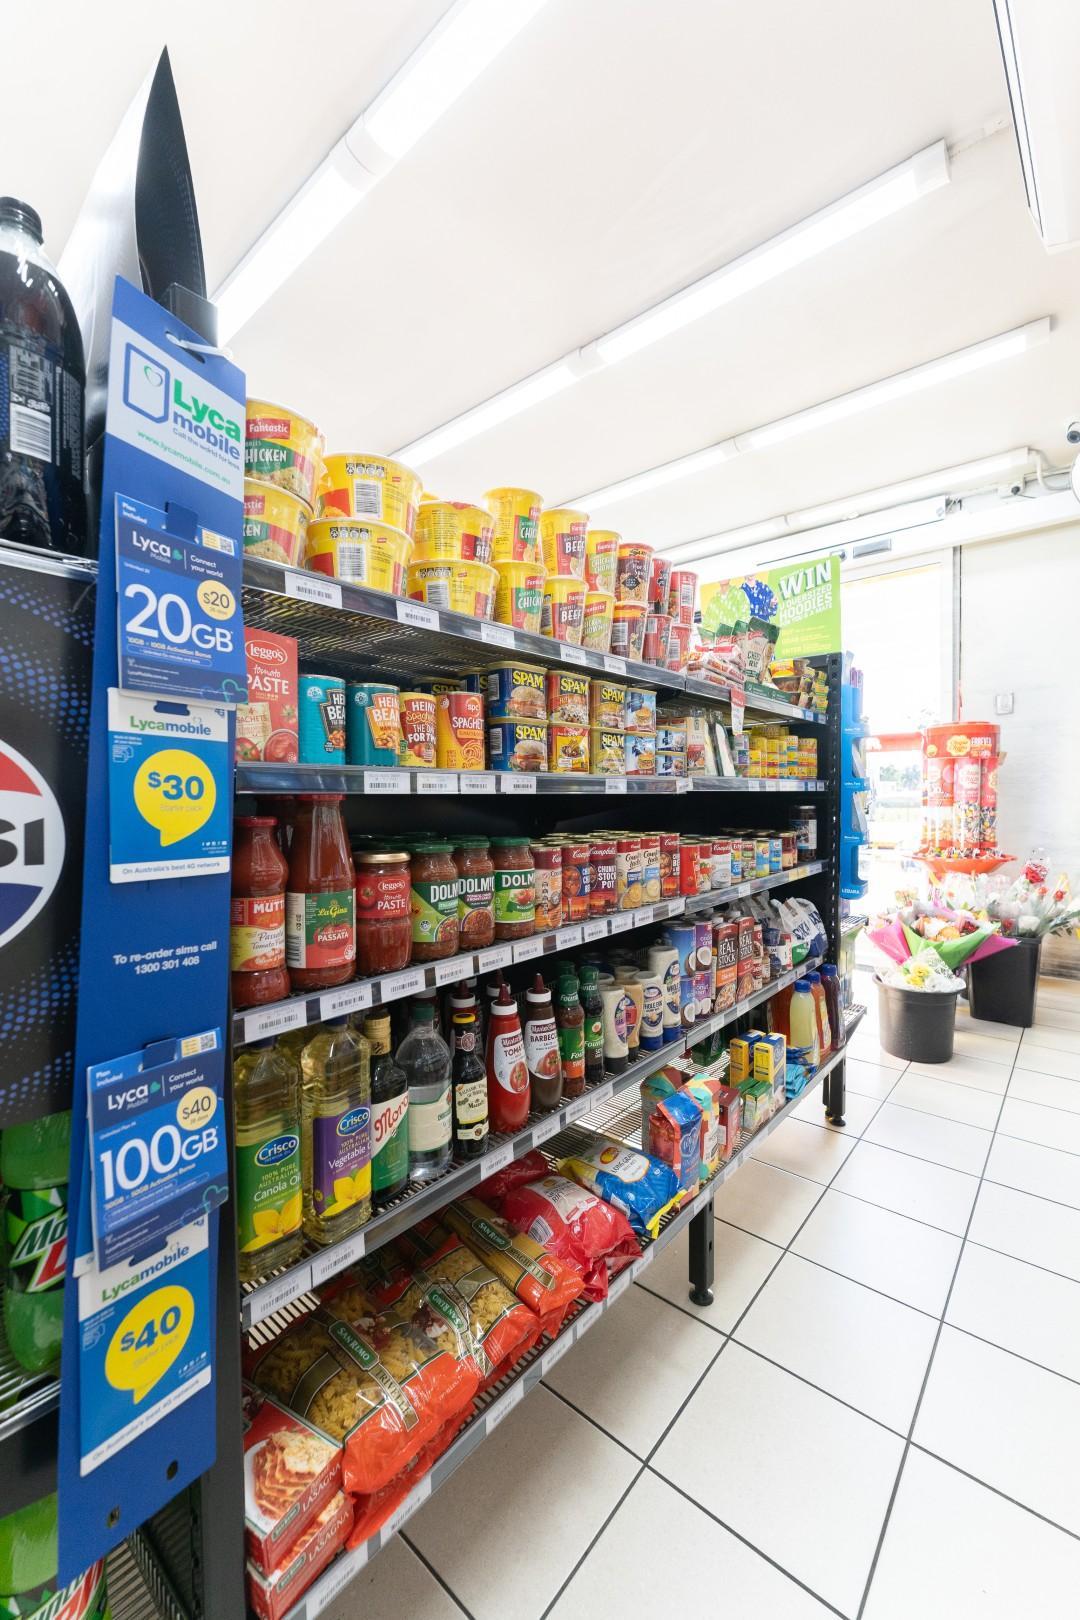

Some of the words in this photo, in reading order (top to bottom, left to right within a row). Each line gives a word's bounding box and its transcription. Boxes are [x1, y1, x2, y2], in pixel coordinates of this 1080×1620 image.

[173, 379, 241, 443] Lyca
[173, 411, 240, 460] mobile
[249, 423, 288, 433] Fantastic
[132, 531, 171, 557] Lyca
[190, 554, 216, 568] Connect
[190, 564, 205, 573] your
[206, 567, 223, 578] world
[779, 559, 832, 600] WIN
[203, 592, 230, 609] $20
[780, 592, 832, 618] HOODIES
[125, 583, 233, 653] 20GB
[561, 609, 581, 623] BEEF
[250, 643, 284, 663] Leggo's
[254, 665, 281, 678] tomato
[512, 671, 544, 688] SPAM
[561, 679, 588, 694] SPAM
[602, 688, 624, 701] SPAM
[130, 715, 211, 736] Lycamobile
[236, 713, 267, 723] SACHETS
[413, 725, 425, 733] THE
[515, 725, 546, 741] SPAM
[408, 733, 425, 743] FOR
[602, 733, 624, 746] SPAM
[148, 771, 204, 801] $30
[135, 864, 170, 873] Australia's
[171, 863, 185, 871] best
[601, 880, 615, 889] POT
[378, 898, 405, 910] PASTE
[318, 931, 349, 942] PASSATA
[740, 934, 752, 948] REAL
[114, 954, 127, 965] To
[130, 948, 173, 963] re-order
[175, 945, 198, 956] sims
[200, 941, 217, 952] call
[252, 941, 274, 951] Tomato
[719, 941, 735, 955] REAL
[740, 945, 753, 959] STOCK
[134, 962, 160, 975] 1300
[162, 959, 180, 971] 301
[719, 954, 736, 968] STOCK
[96, 1070, 111, 1079] Plan
[96, 1073, 123, 1087] included
[169, 1068, 197, 1082] Connect
[169, 1082, 184, 1093] your
[186, 1074, 204, 1086] world
[108, 1084, 149, 1110] Lyca
[182, 1096, 211, 1120] $40
[340, 1112, 369, 1131] Crisco
[258, 1139, 297, 1160] Crisco
[341, 1139, 354, 1148] 100%
[100, 1124, 218, 1200] 100GB
[329, 1146, 366, 1169] Vegetable
[258, 1169, 299, 1189] AUSTRALIAN
[262, 1169, 279, 1181] 100%
[280, 1162, 297, 1173] PURE
[254, 1182, 287, 1202] Canola
[101, 1246, 189, 1303] Lycamobile
[432, 1294, 450, 1312] REMO
[449, 1310, 464, 1329] SAN
[120, 1305, 182, 1352] $40
[337, 1327, 350, 1343] SAN
[350, 1343, 370, 1361] REMO
